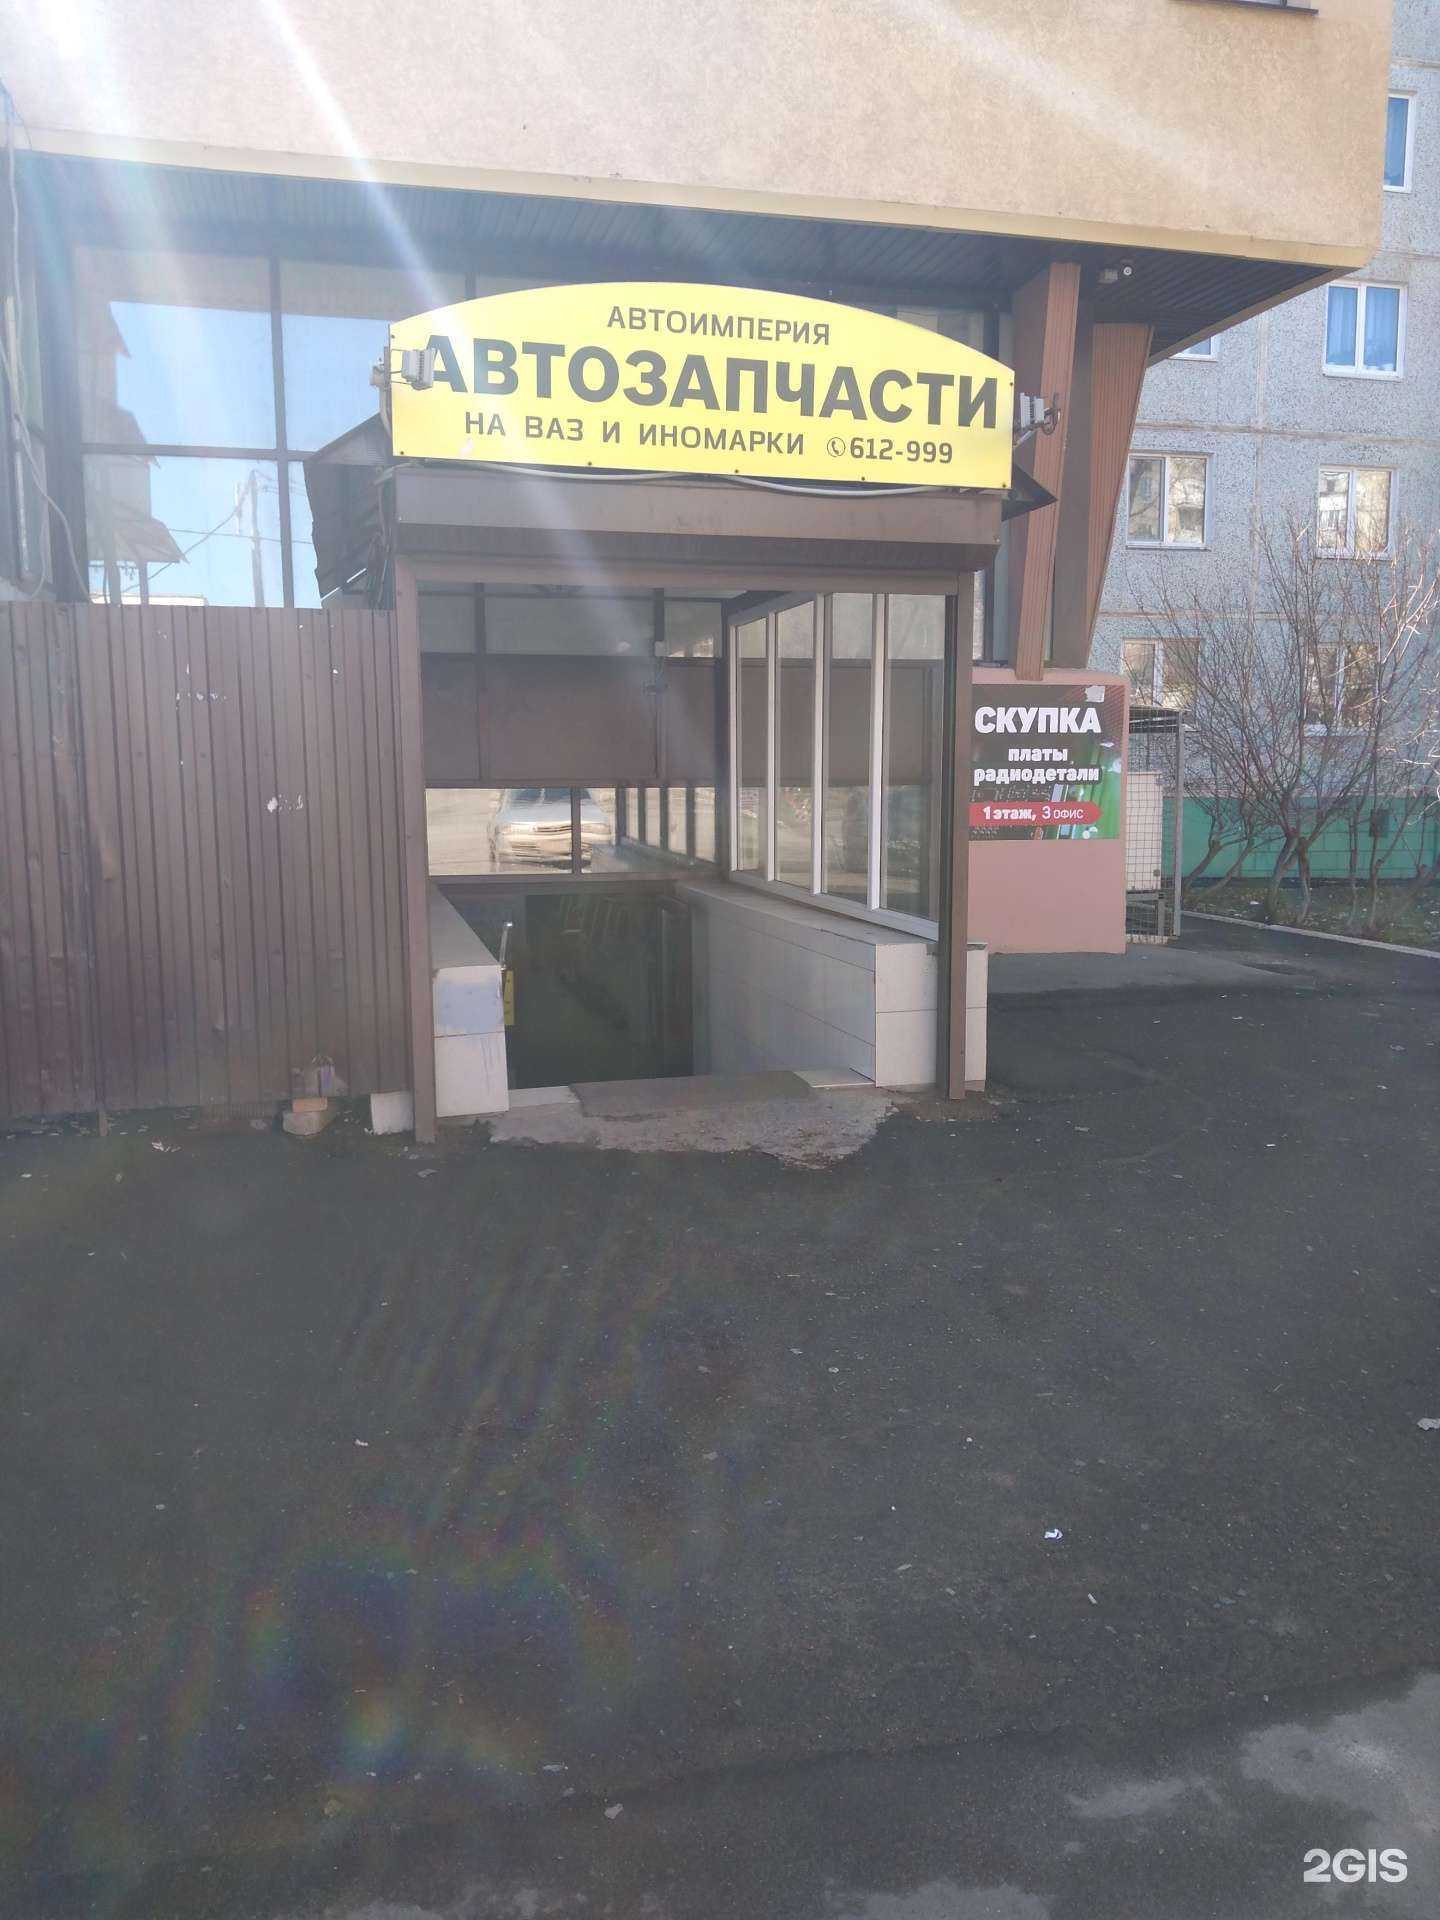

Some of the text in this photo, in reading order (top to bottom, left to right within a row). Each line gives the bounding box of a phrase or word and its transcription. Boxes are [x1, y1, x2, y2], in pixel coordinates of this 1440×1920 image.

[607, 306, 830, 345] АВТОИМПЕРИЯ
[425, 334, 998, 429] АВТОЗАПЧАСТИ
[465, 411, 953, 464] НА ВАЗ И ИНОМАРКИ 612-999
[974, 706, 1101, 734] СКУПКА
[973, 767, 1100, 786] радиодетали
[1042, 806, 1051, 820] 3
